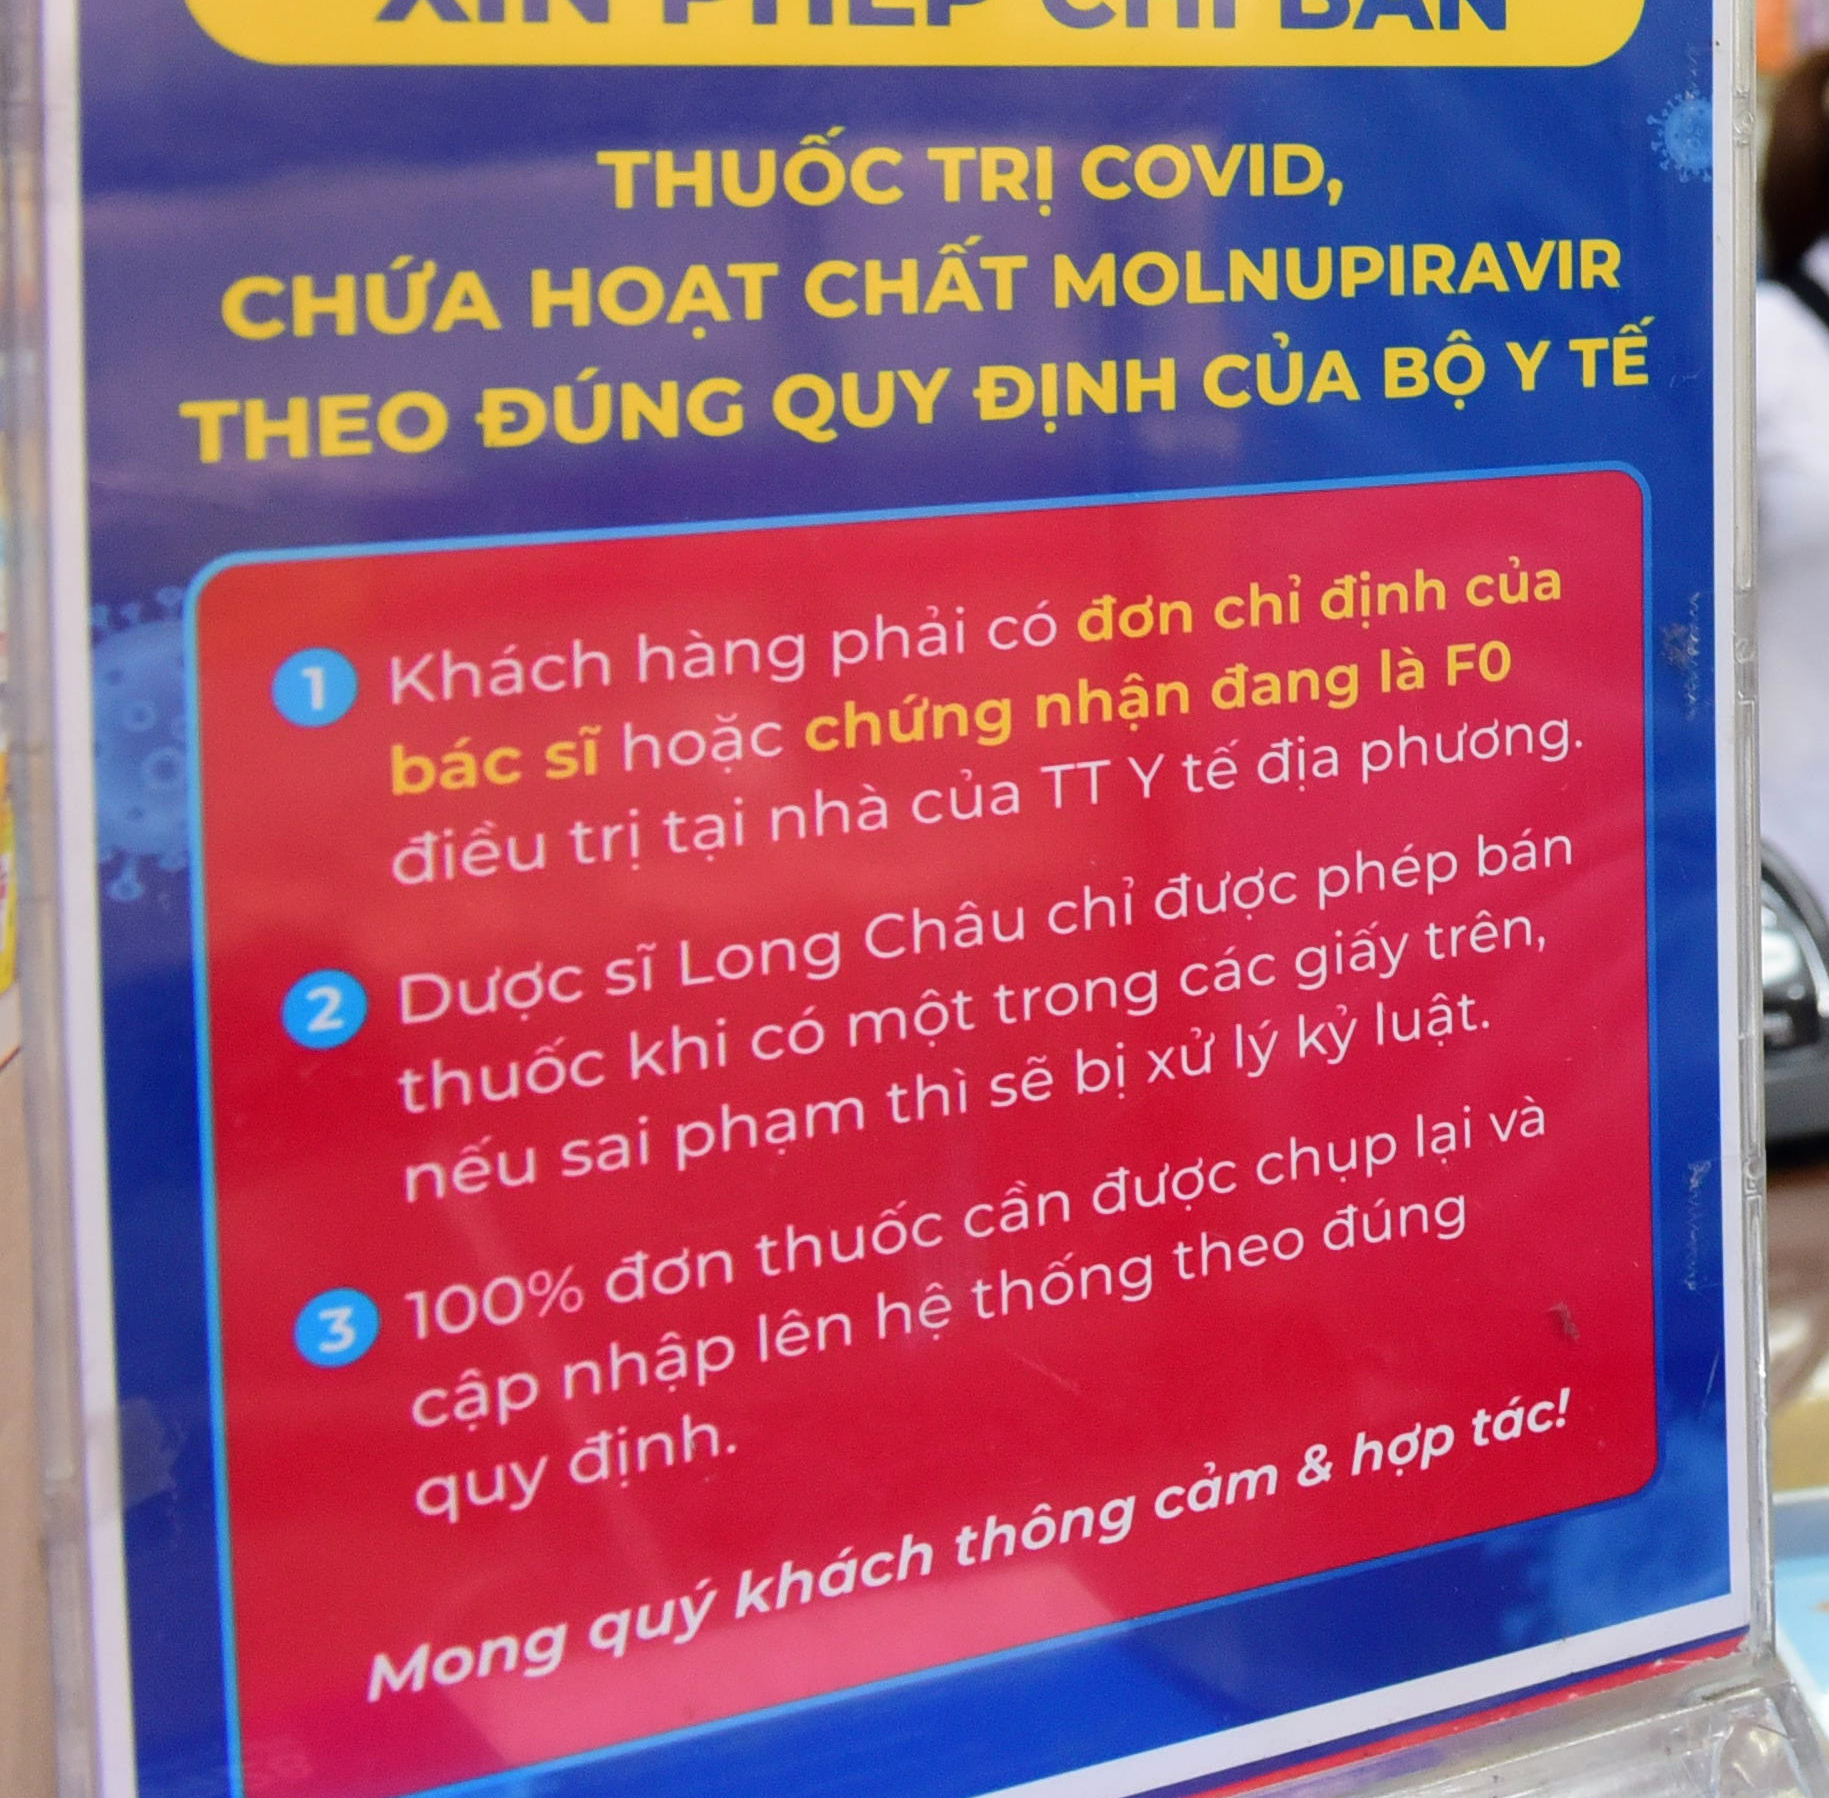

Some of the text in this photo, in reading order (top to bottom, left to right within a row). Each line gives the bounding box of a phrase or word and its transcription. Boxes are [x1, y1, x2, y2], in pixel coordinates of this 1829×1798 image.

[597, 127, 1342, 216] THUỐC TRỊ COVID,
[222, 235, 1620, 339] CHỨA HOẠT CHẤT MOLNUPIRAVIR
[180, 317, 1654, 463] THEO ĐÚNG QUY ĐỊNH CỦA BỘ Y TẾ
[301, 556, 1560, 711] 1 Khách hàng phải có đơn chỉ định của
[392, 641, 1511, 795] bác sĩ hoặc chứng nhận đang là F0
[393, 719, 1582, 884] điều trị tại nhà của TT Y tế địa phương.
[304, 829, 1571, 1034] 2 Dược sĩ Long Châu chỉ được phép bán
[399, 910, 1545, 1113] thuốc khi có một trong các giấy trên,
[406, 993, 1489, 1202] nếu sai phạm thì sẽ bị xử lý kỷ luật.
[316, 1096, 1544, 1354] 3 100% đơn thuốc cần được chụp lại và
[412, 1195, 1465, 1431] cập nhập lên hệ thống theo đúng
[369, 1388, 1570, 1701] Mong quý khách thông cảm & hợp tác!
[416, 1414, 736, 1523] quy định.
